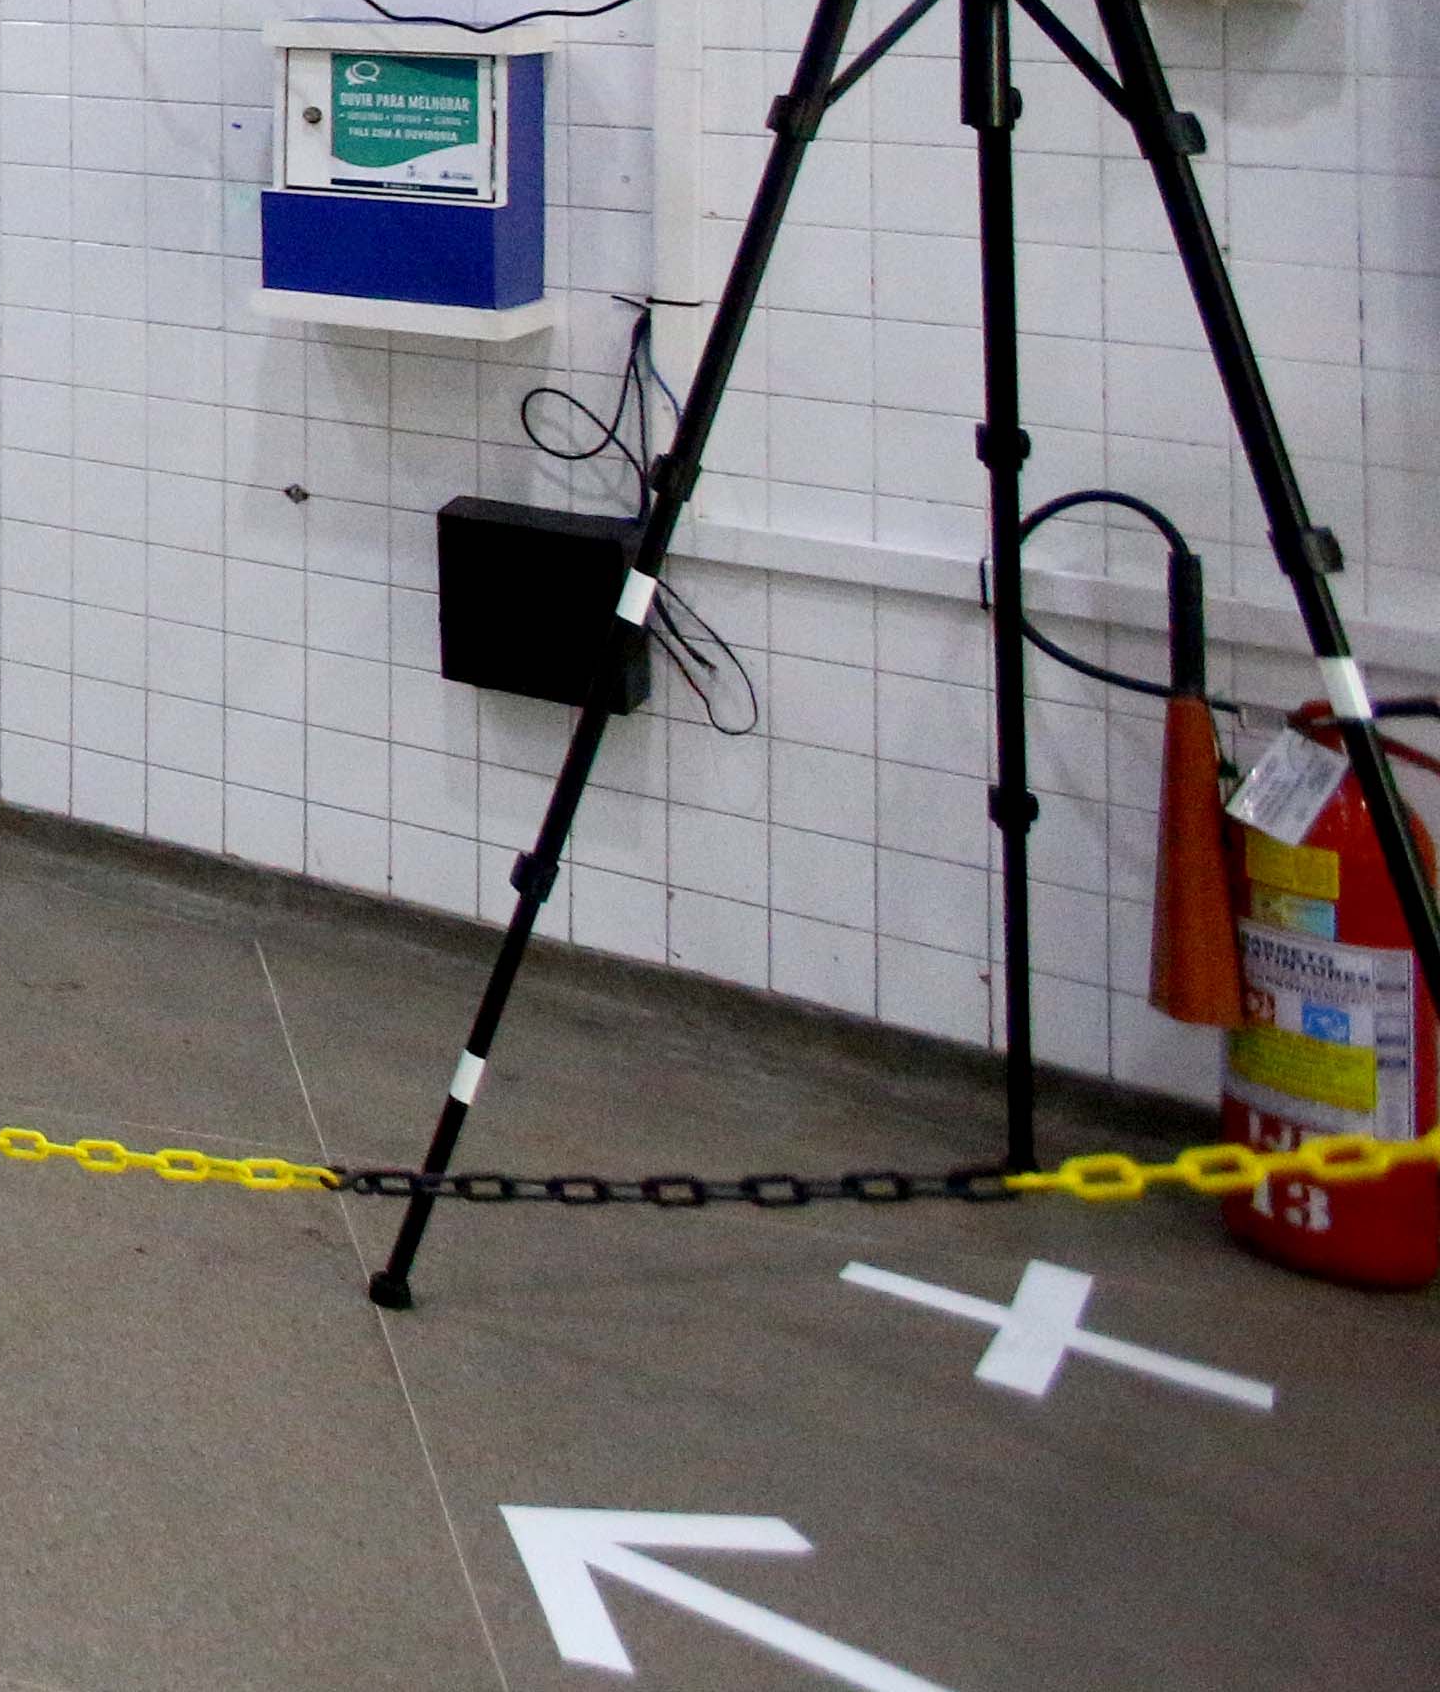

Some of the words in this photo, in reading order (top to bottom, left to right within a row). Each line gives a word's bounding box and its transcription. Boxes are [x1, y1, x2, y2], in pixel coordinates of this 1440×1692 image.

[340, 92, 374, 107] OUVIR
[376, 93, 406, 109] PARA
[408, 95, 471, 112] MELHORAR
[372, 128, 393, 139] COM
[394, 128, 402, 139] A
[405, 129, 459, 143] OUVIDORIA
